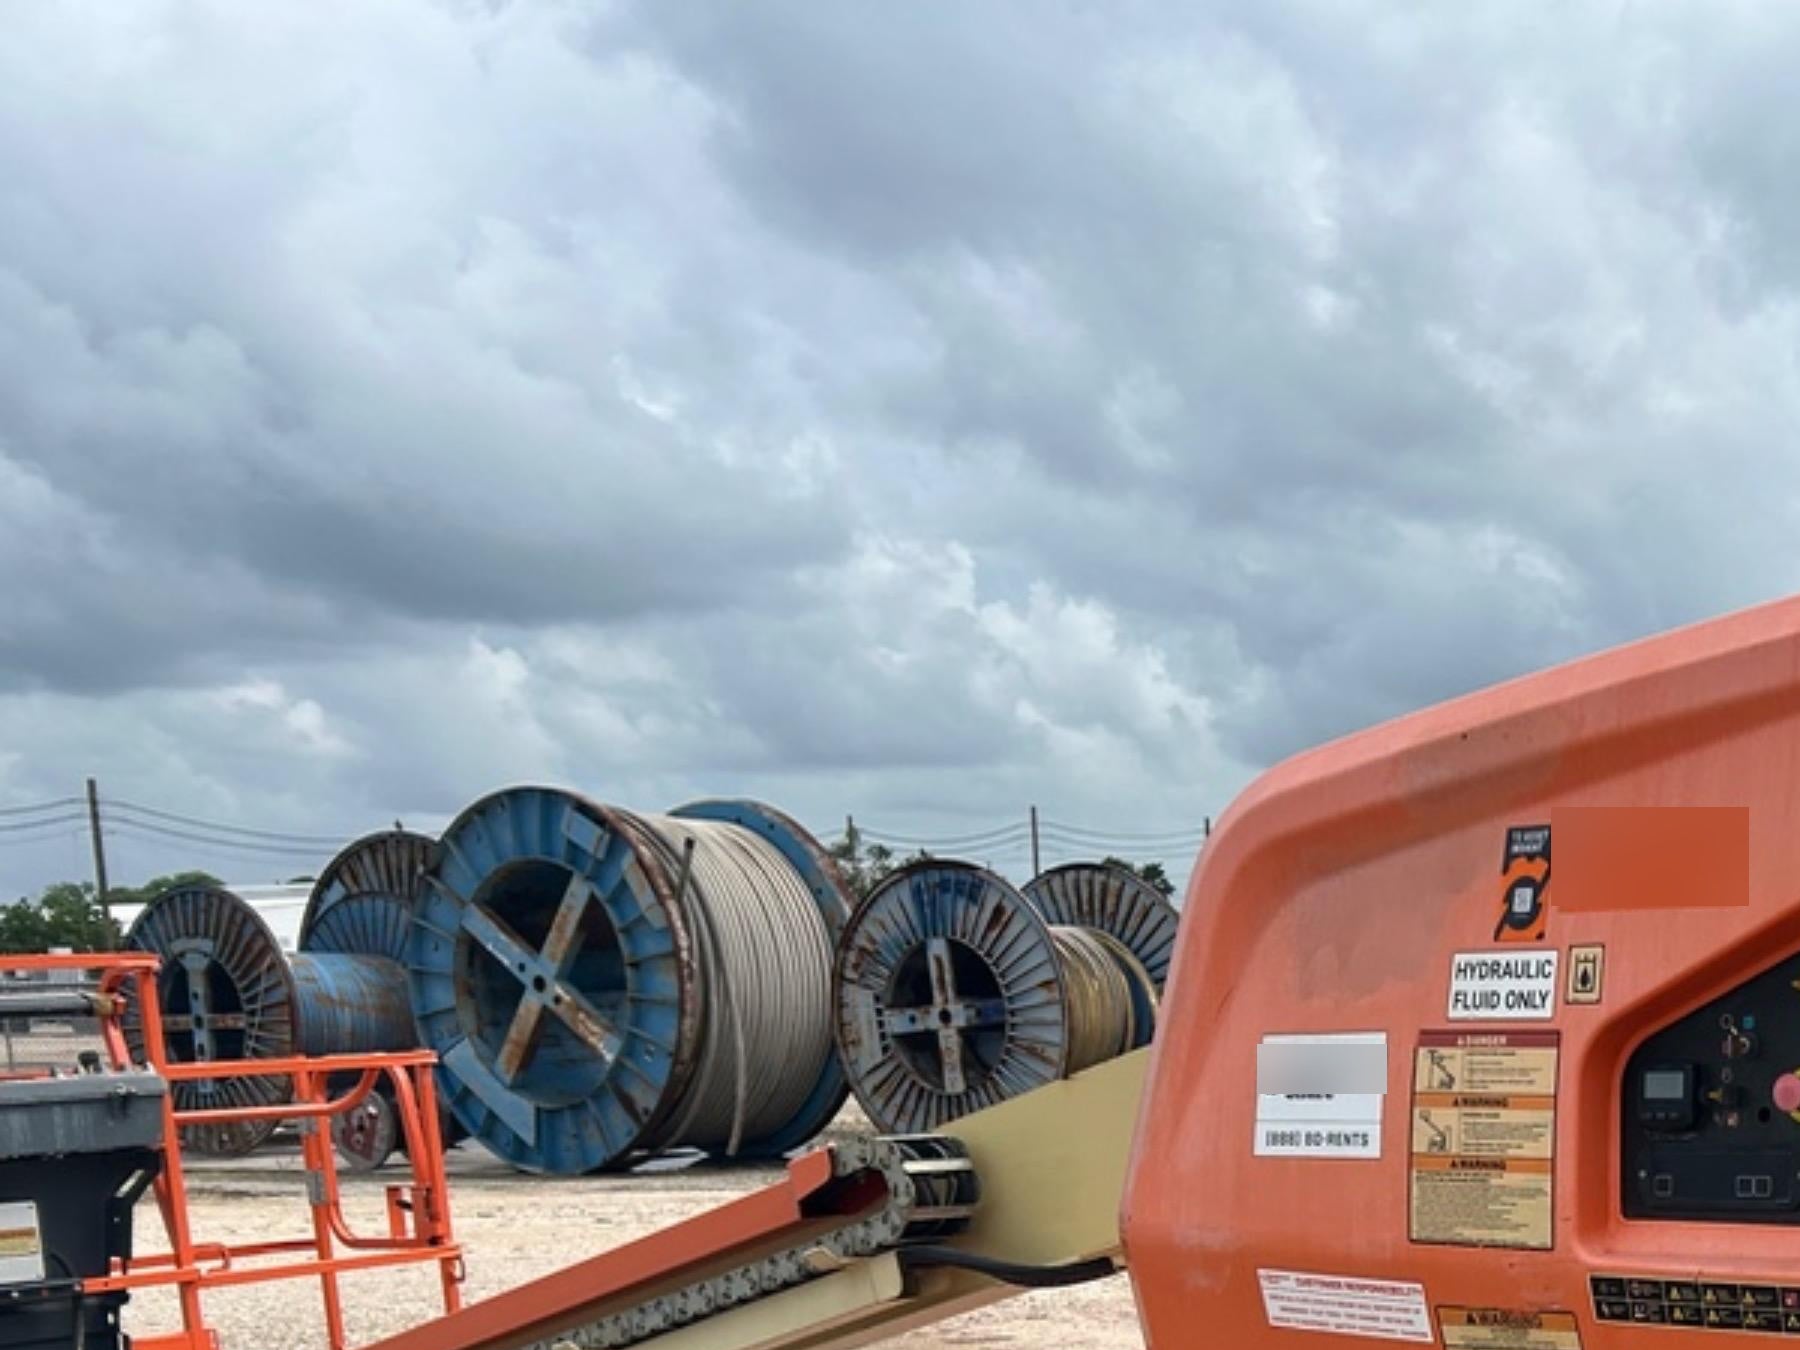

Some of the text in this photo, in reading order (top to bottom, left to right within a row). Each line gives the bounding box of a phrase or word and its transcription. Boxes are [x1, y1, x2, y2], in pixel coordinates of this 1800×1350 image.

[1455, 960, 1554, 980] HYDRAULIC
[1453, 989, 1551, 1011] FLUID ONLY
